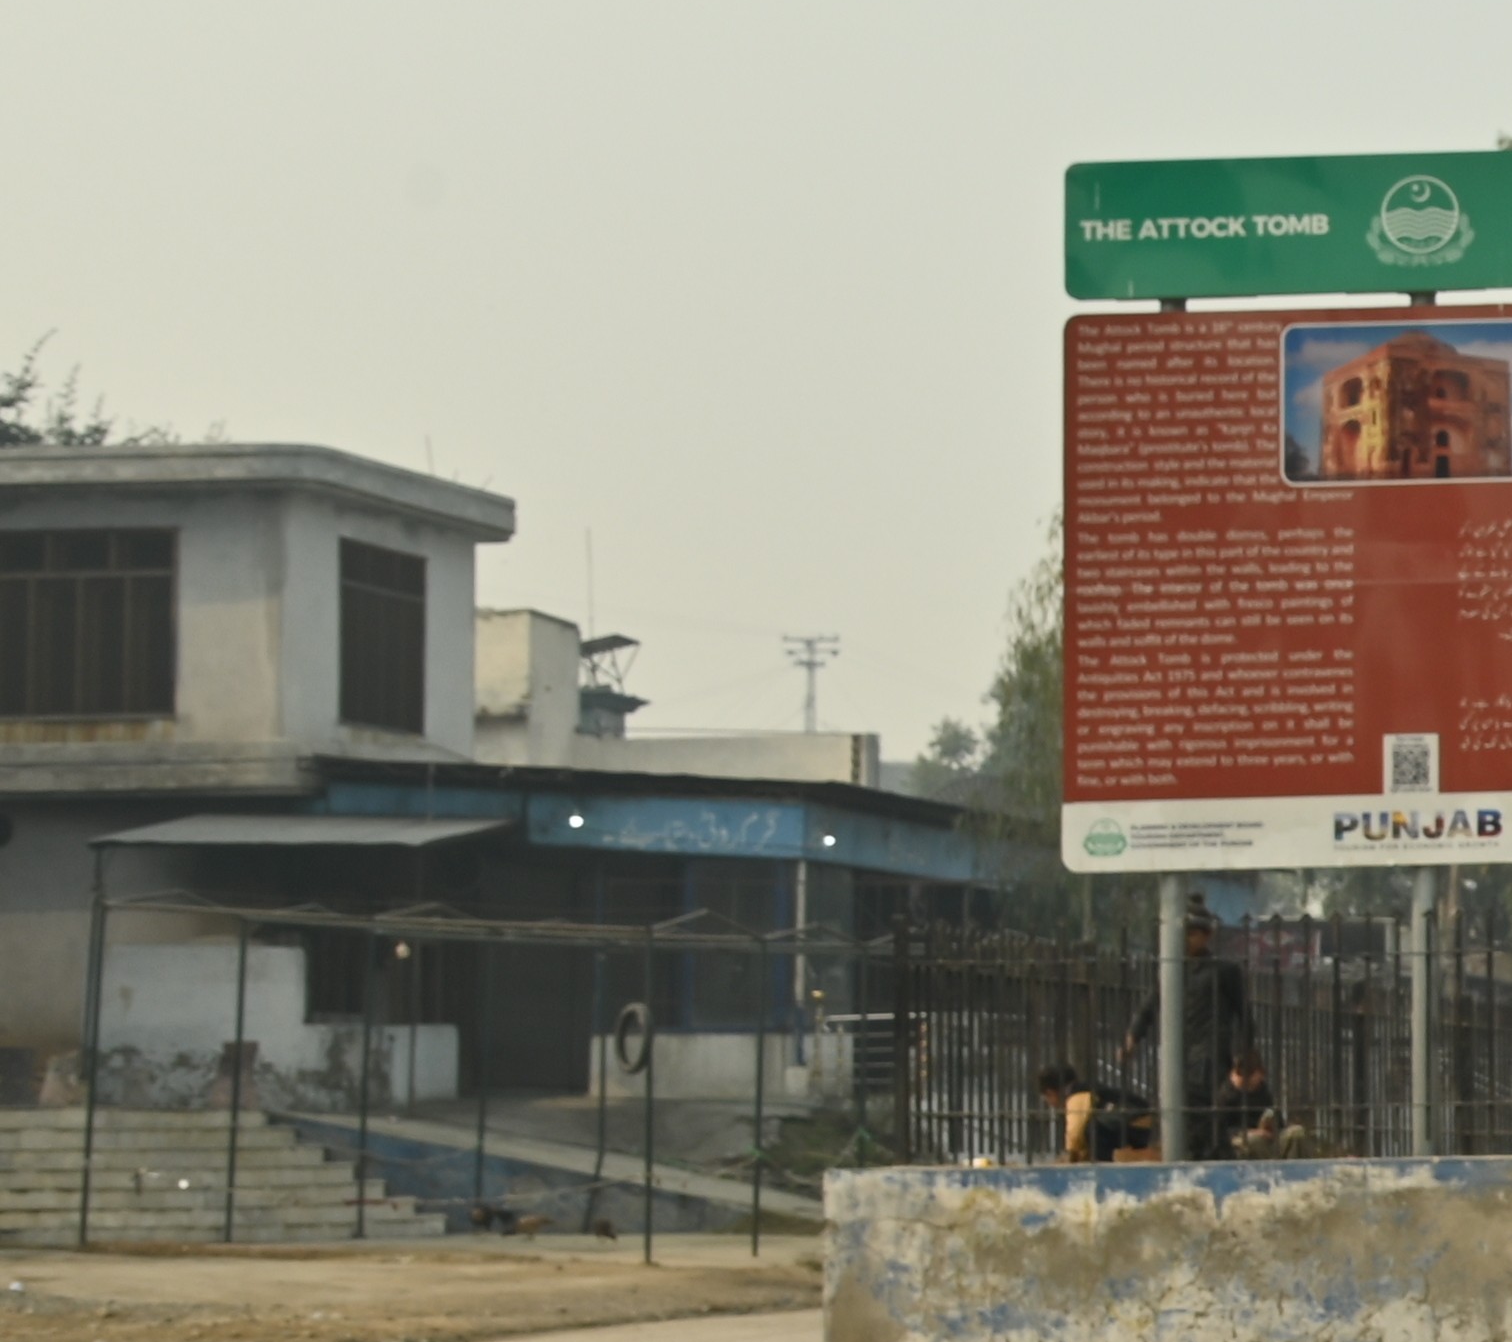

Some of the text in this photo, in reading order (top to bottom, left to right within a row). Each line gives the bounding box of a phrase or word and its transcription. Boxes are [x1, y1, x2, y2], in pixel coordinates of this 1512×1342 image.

[1081, 213, 1330, 241] THE ATTOCK TOMB
[1334, 809, 1502, 841] PUNJAB
